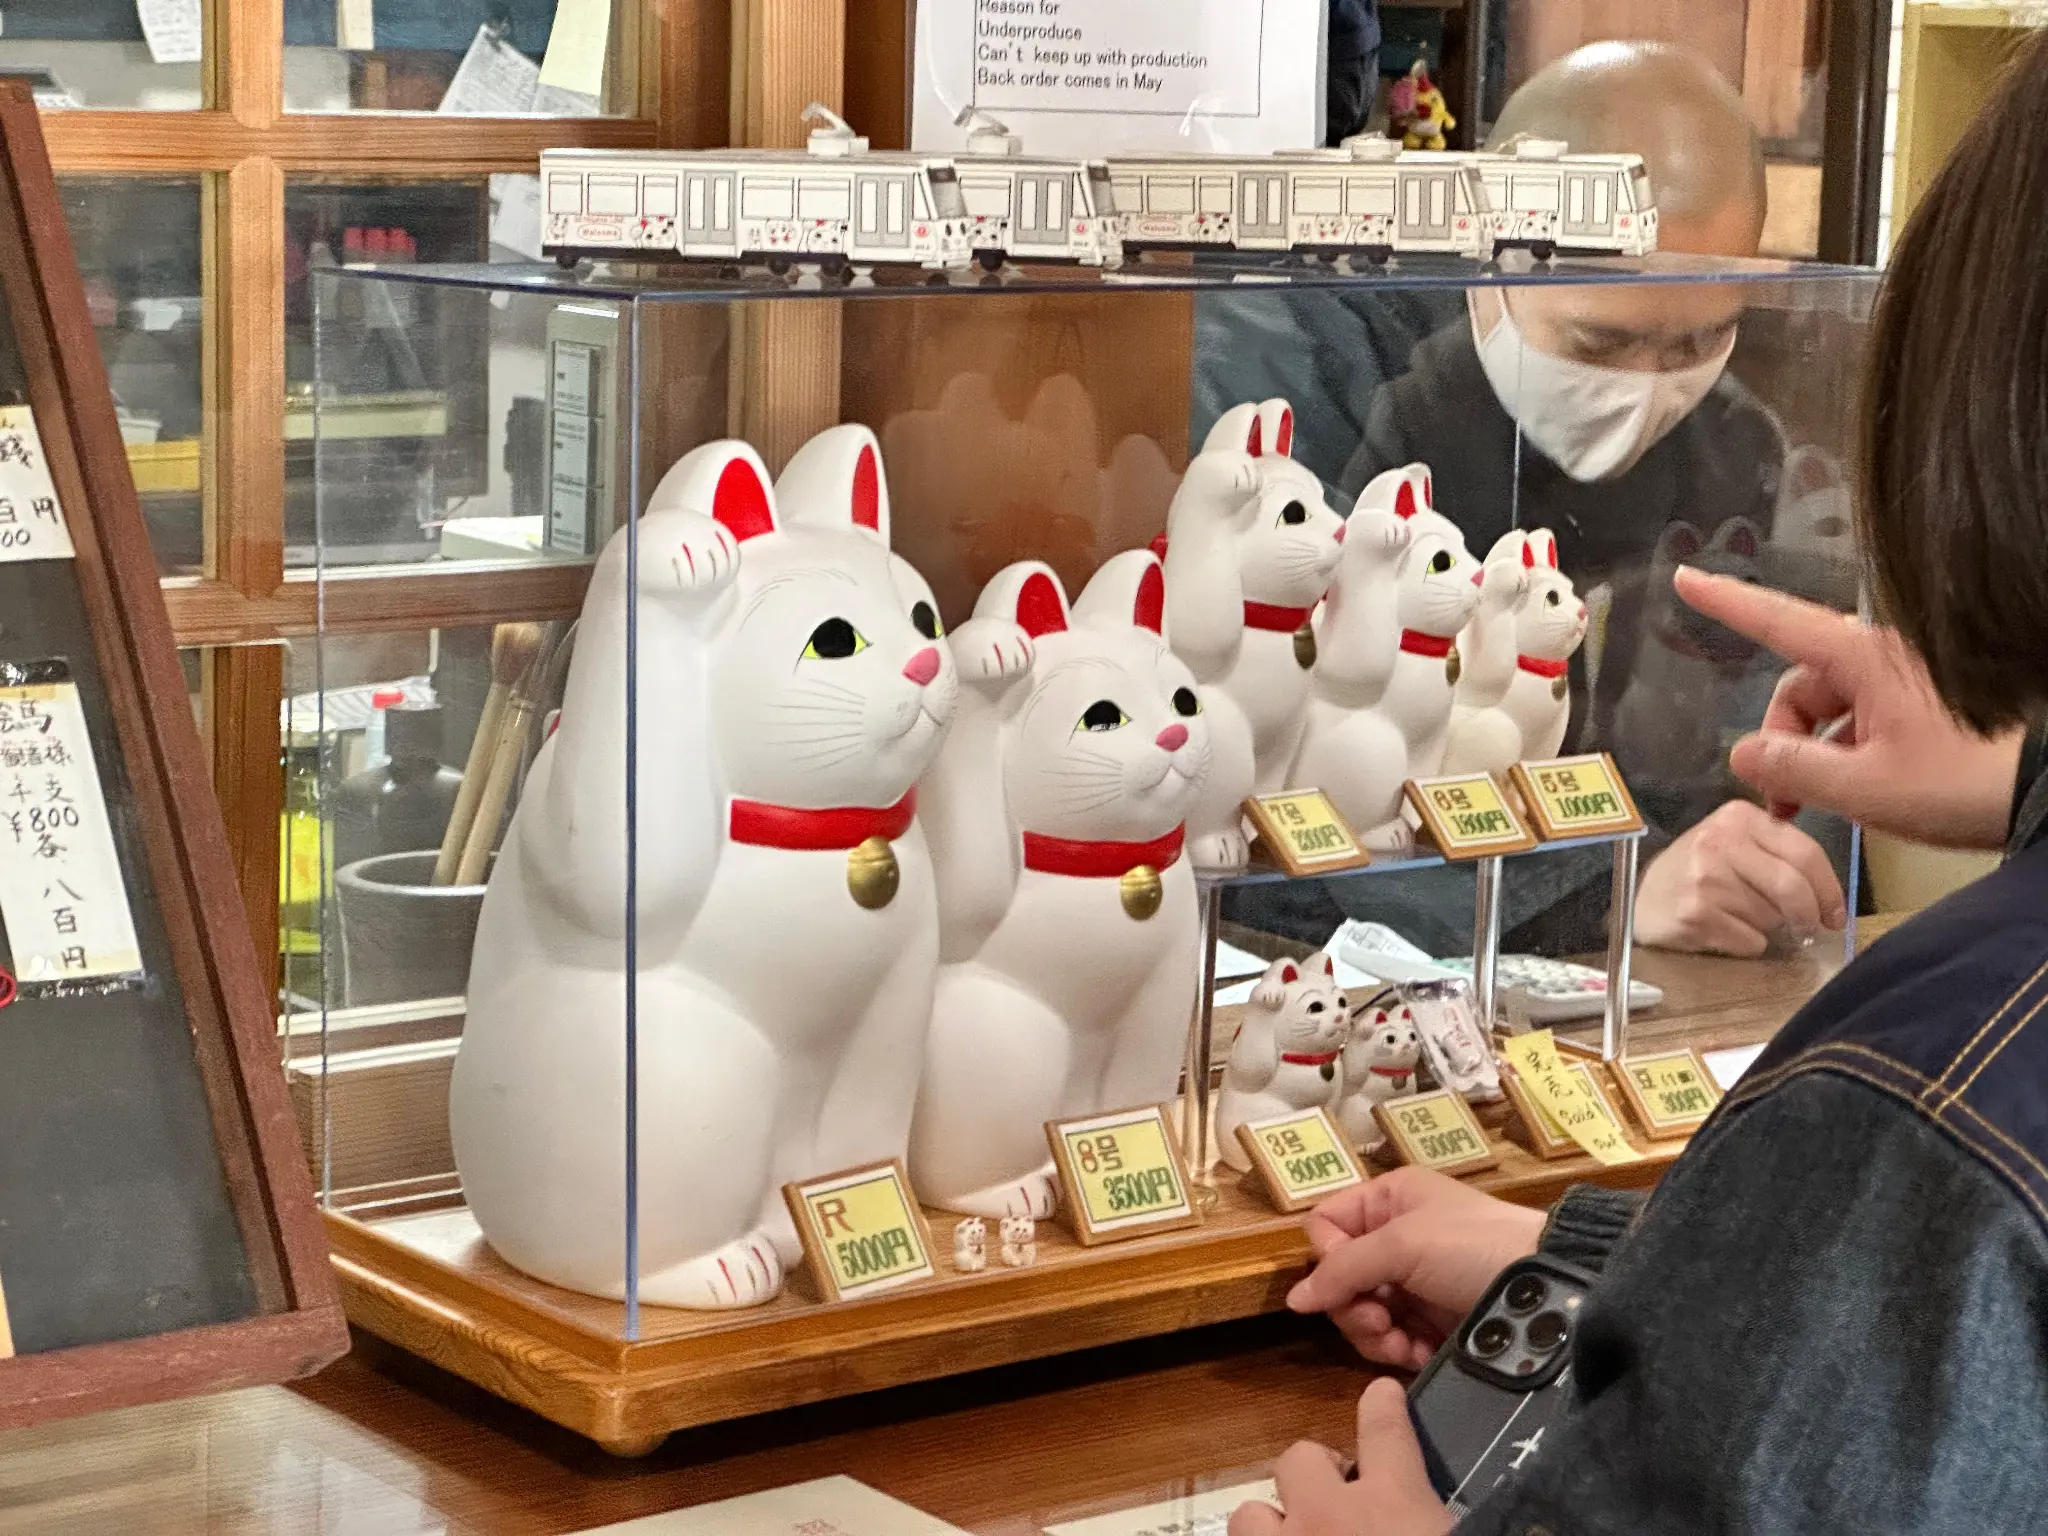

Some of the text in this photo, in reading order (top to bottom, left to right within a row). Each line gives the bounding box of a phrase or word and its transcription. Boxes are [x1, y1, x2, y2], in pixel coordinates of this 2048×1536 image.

[980, 0, 1061, 15] Reason for
[979, 19, 1083, 41] Underproduce
[1034, 46, 1069, 65] keep
[1074, 52, 1092, 66] up
[1098, 50, 1127, 66] with
[1131, 52, 1208, 69] production
[978, 67, 1163, 93] Back order comes in May
[1077, 1134, 1122, 1173] 8号
[1265, 1129, 1306, 1157] 3号
[1101, 1166, 1177, 1211] 3500円
[816, 1199, 855, 1237] R
[836, 1227, 915, 1279] 5000円
